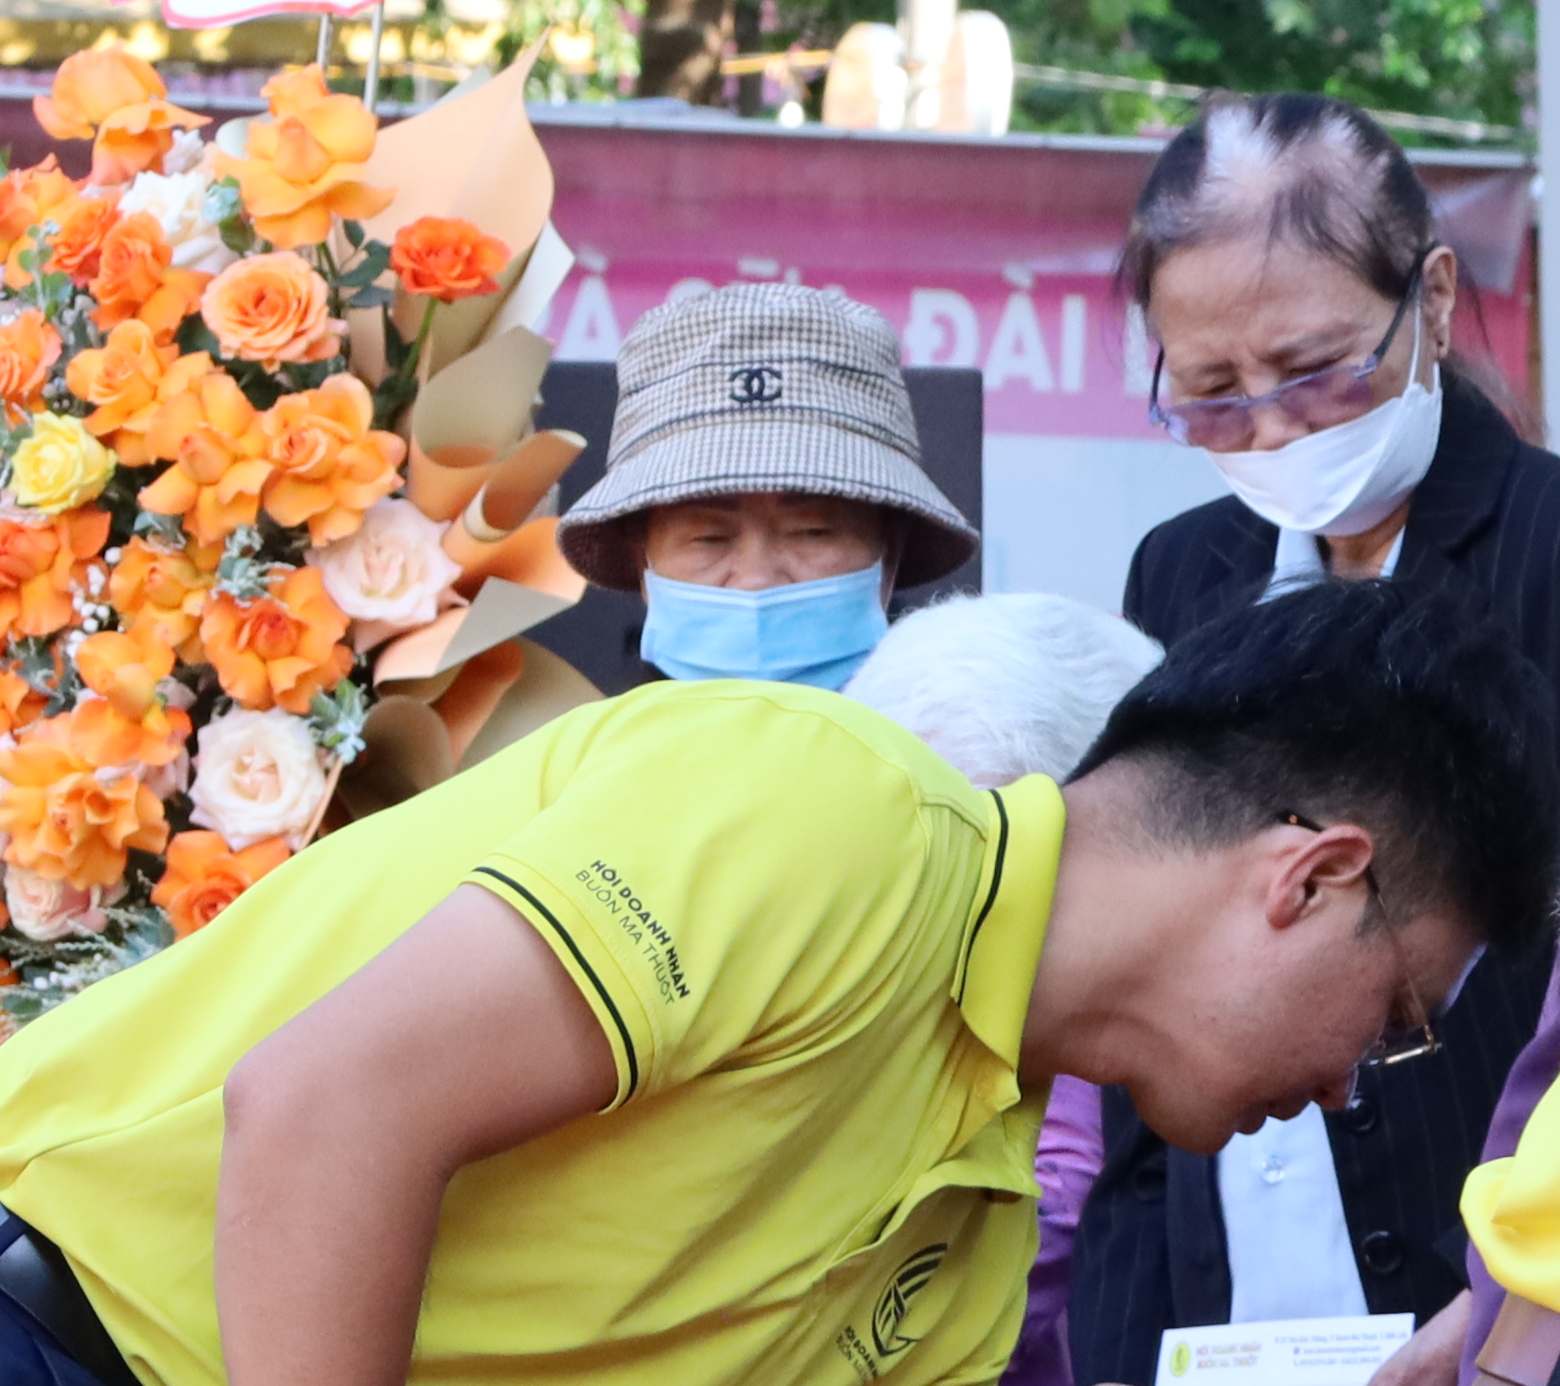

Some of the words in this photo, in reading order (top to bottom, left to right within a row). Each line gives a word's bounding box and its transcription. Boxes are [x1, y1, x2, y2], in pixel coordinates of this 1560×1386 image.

[902, 264, 1087, 394] ĐÀI
[575, 869, 622, 914] BUÔN
[618, 915, 645, 945] MA
[590, 859, 623, 888] HỘI
[618, 886, 672, 946] DOANH
[665, 945, 691, 999] NHÂN
